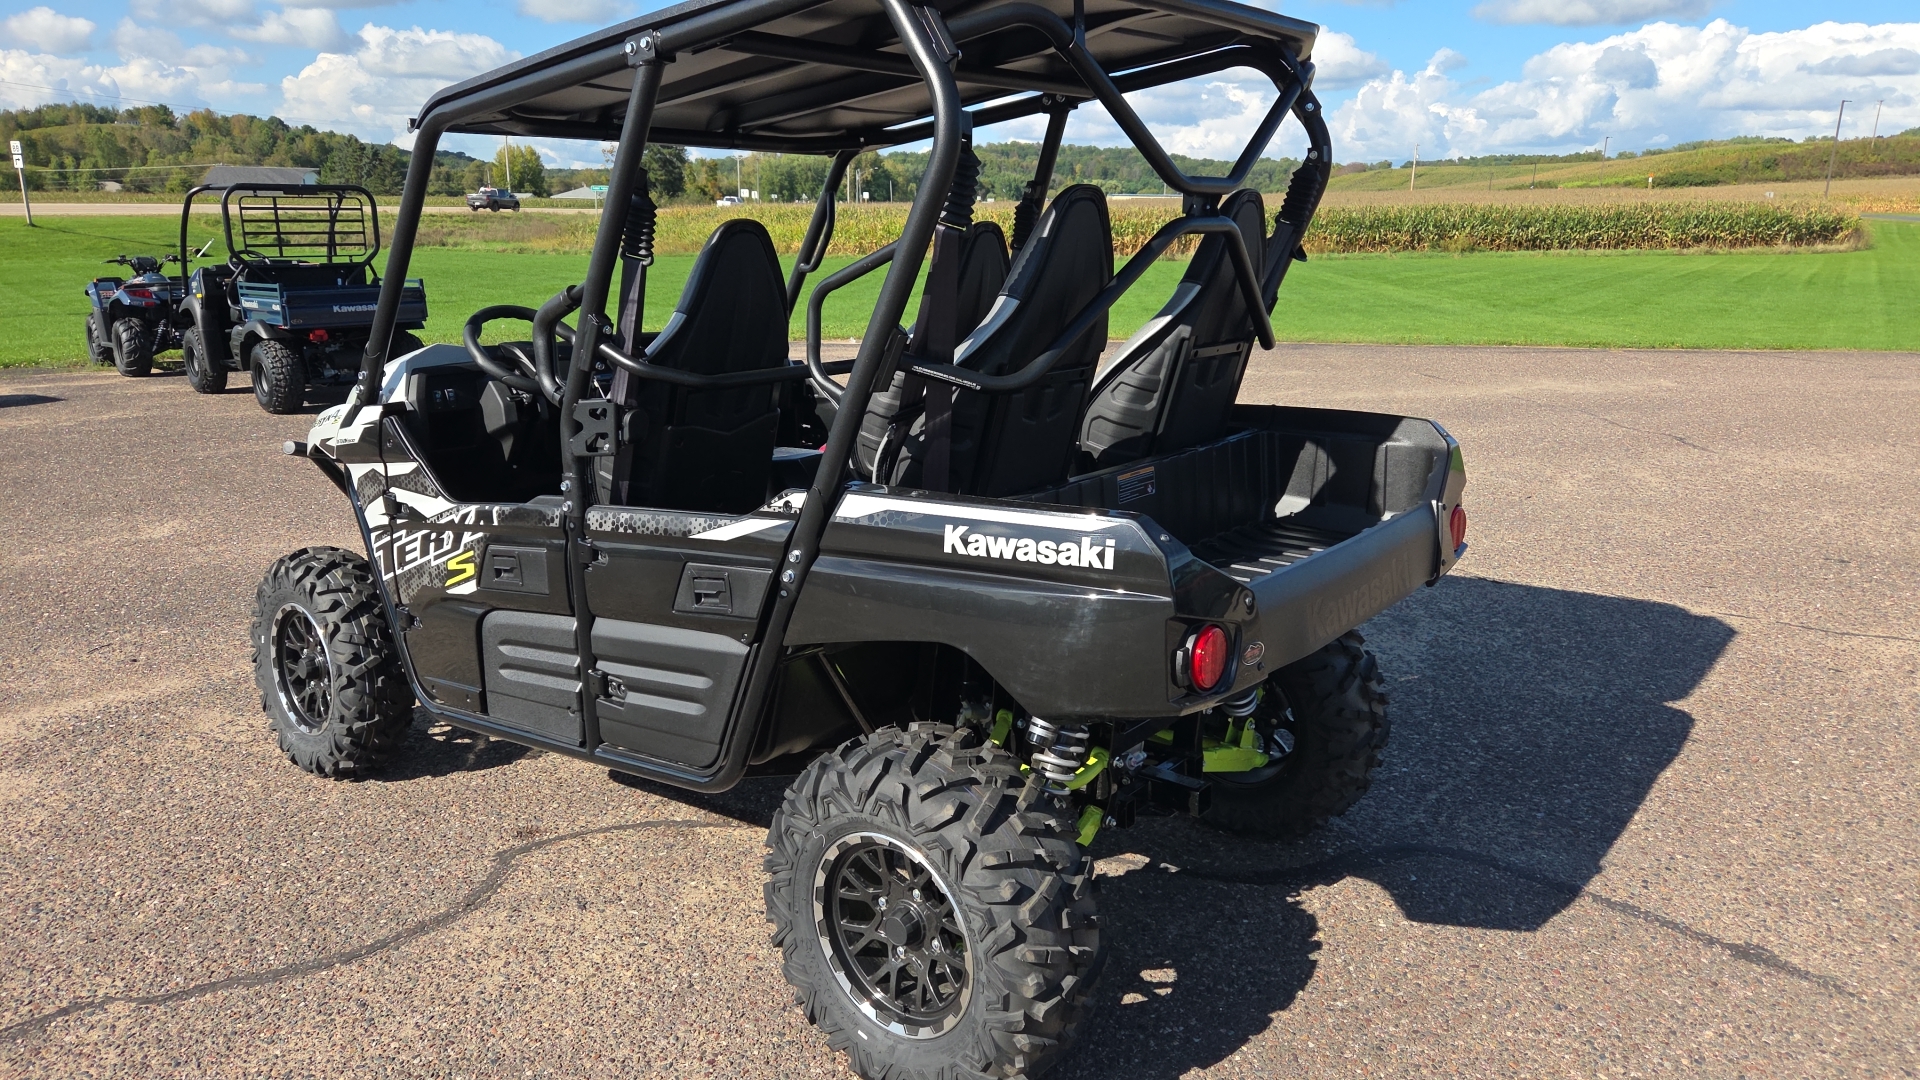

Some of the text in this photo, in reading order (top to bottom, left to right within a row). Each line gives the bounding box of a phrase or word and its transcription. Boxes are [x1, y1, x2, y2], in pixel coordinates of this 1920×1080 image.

[333, 303, 379, 313] Kawasak
[943, 523, 1116, 571] Kawasaki
[445, 550, 475, 587] S
[1306, 550, 1413, 644] Kawasaki
